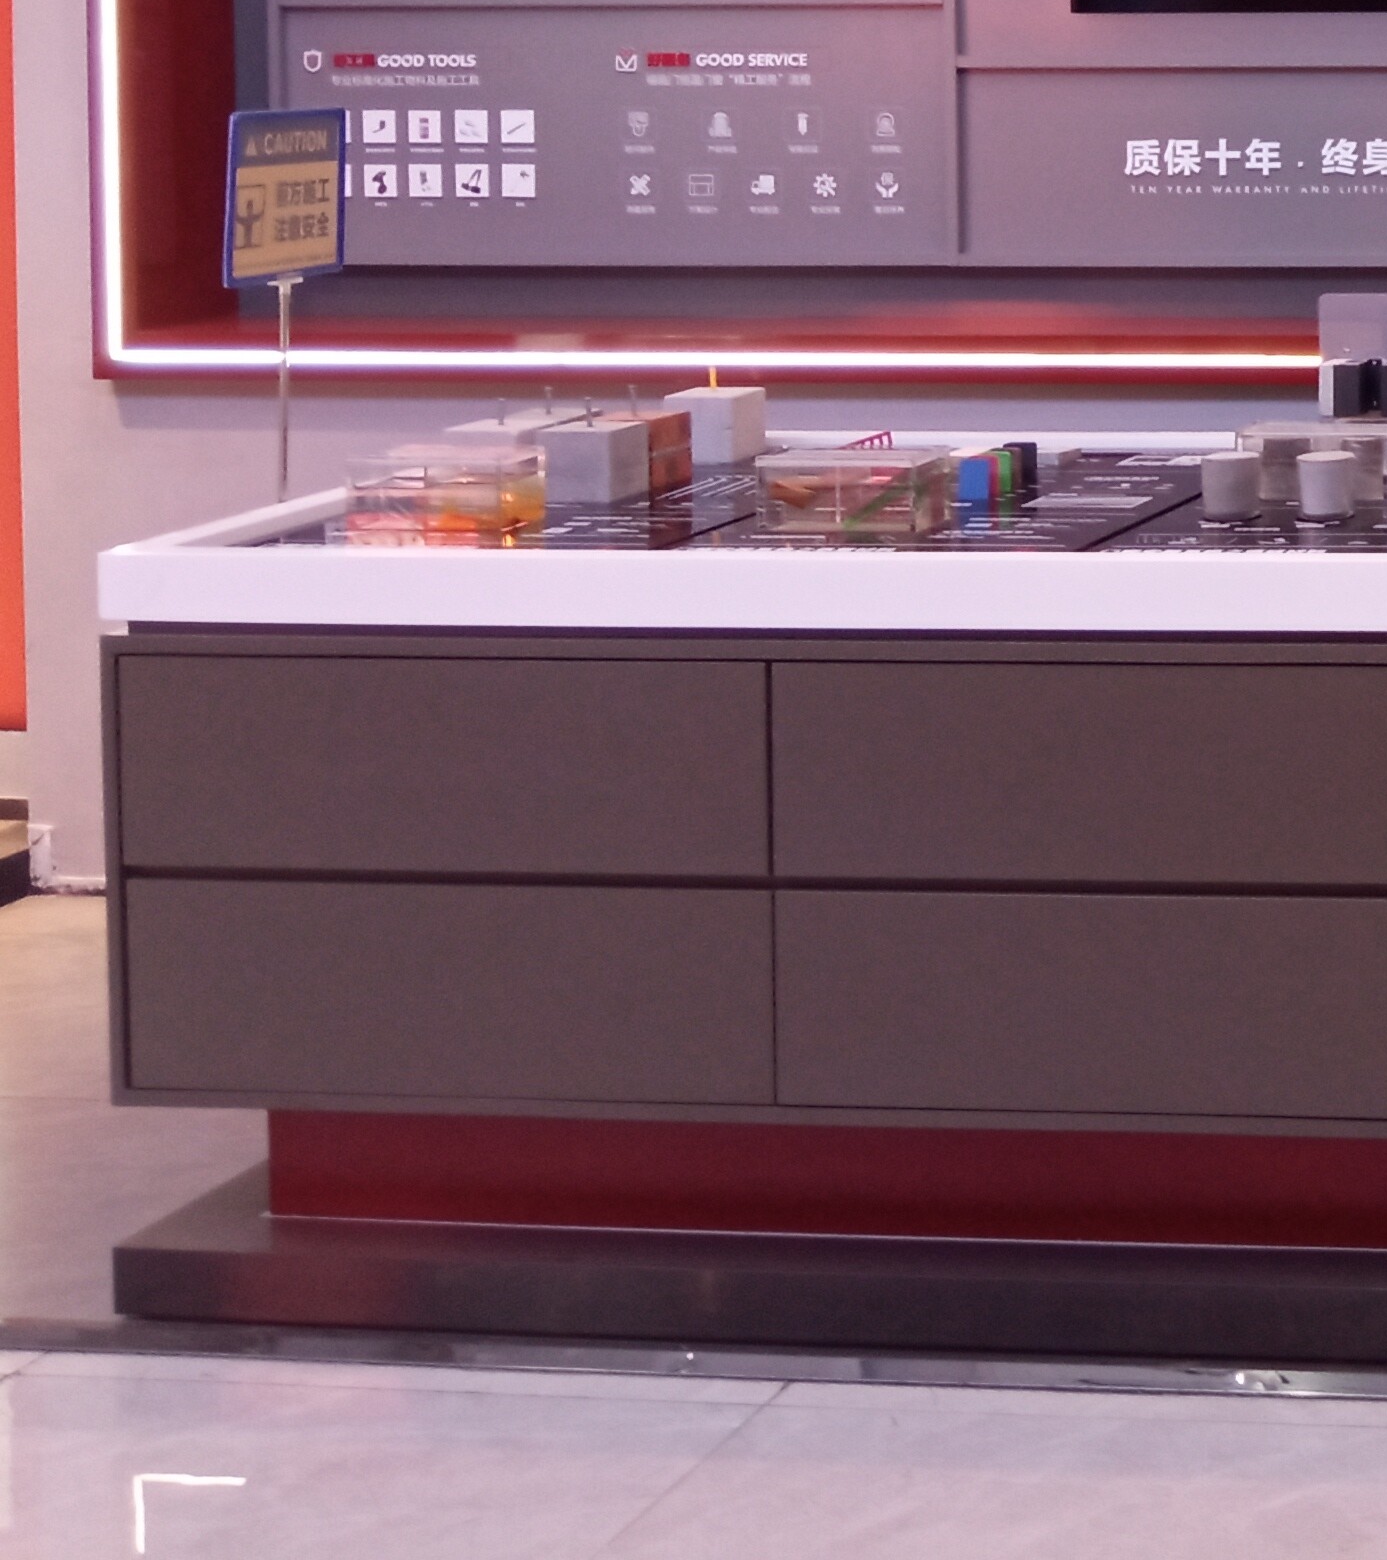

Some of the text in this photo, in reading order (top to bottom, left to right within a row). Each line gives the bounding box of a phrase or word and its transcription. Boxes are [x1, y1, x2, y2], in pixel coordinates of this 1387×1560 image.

[377, 54, 425, 67] GOOD
[427, 53, 477, 67] TOOLS
[696, 53, 744, 67] GOOD
[748, 53, 808, 67] SERVICE
[264, 129, 328, 156] CAUTION
[1123, 137, 1283, 177] 质保十年
